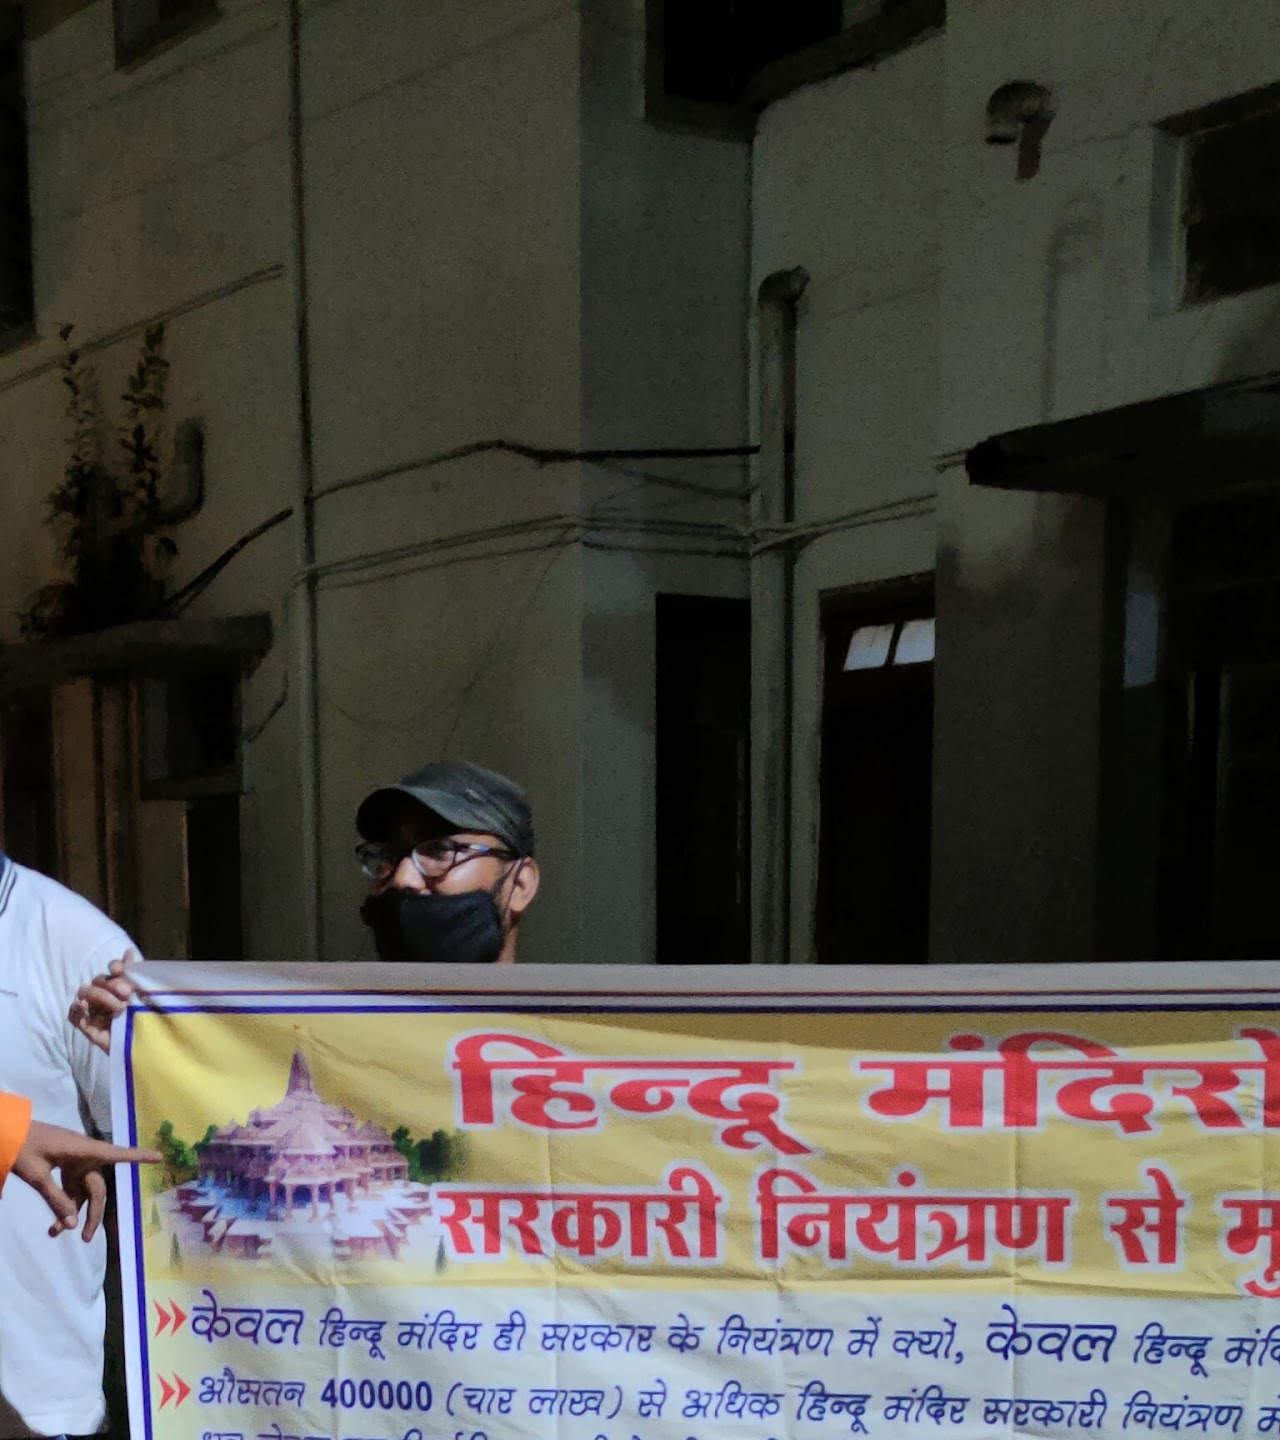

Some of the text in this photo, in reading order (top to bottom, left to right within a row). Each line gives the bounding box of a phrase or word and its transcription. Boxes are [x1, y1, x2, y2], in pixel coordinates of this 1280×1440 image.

[453, 1034, 810, 1155] हिन्दू
[439, 1169, 721, 1257] सरकारी
[757, 1170, 1070, 1262] नियंत्रण
[1108, 1169, 1184, 1263] से
[192, 1290, 304, 1345] केवल
[319, 1307, 387, 1360] हिन्दू
[397, 1310, 482, 1352] मंदिर
[542, 1324, 656, 1352] सरकार
[717, 1315, 833, 1357] नियंत्रण
[986, 1303, 1117, 1363] केवल
[1133, 1322, 1213, 1378] हिन्दू
[199, 1367, 305, 1407] औसतन
[321, 1378, 432, 1411] 400000
[446, 1383, 516, 1416] (चार
[683, 1381, 785, 1418] अधिक
[797, 1381, 871, 1434] हिन्दू
[885, 1385, 971, 1425] मंदिर
[983, 1389, 1107, 1428] सरकारी
[1123, 1390, 1243, 1433] नियंत्रण
